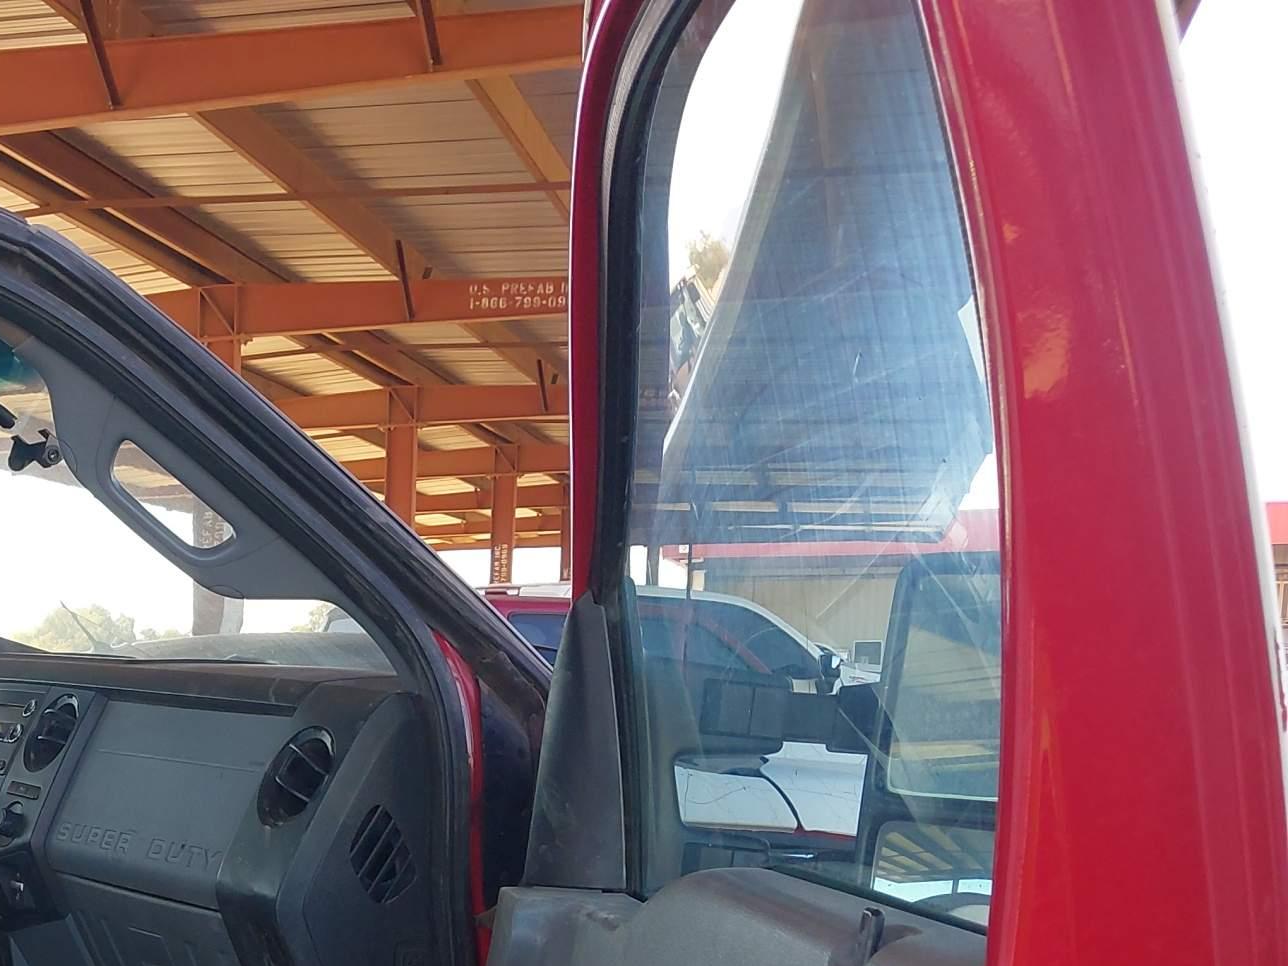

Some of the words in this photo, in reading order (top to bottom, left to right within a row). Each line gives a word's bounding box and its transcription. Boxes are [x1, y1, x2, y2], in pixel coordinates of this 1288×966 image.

[501, 282, 555, 295] PREFAB
[56, 823, 133, 854] SUPER
[146, 838, 223, 871] DUTY
